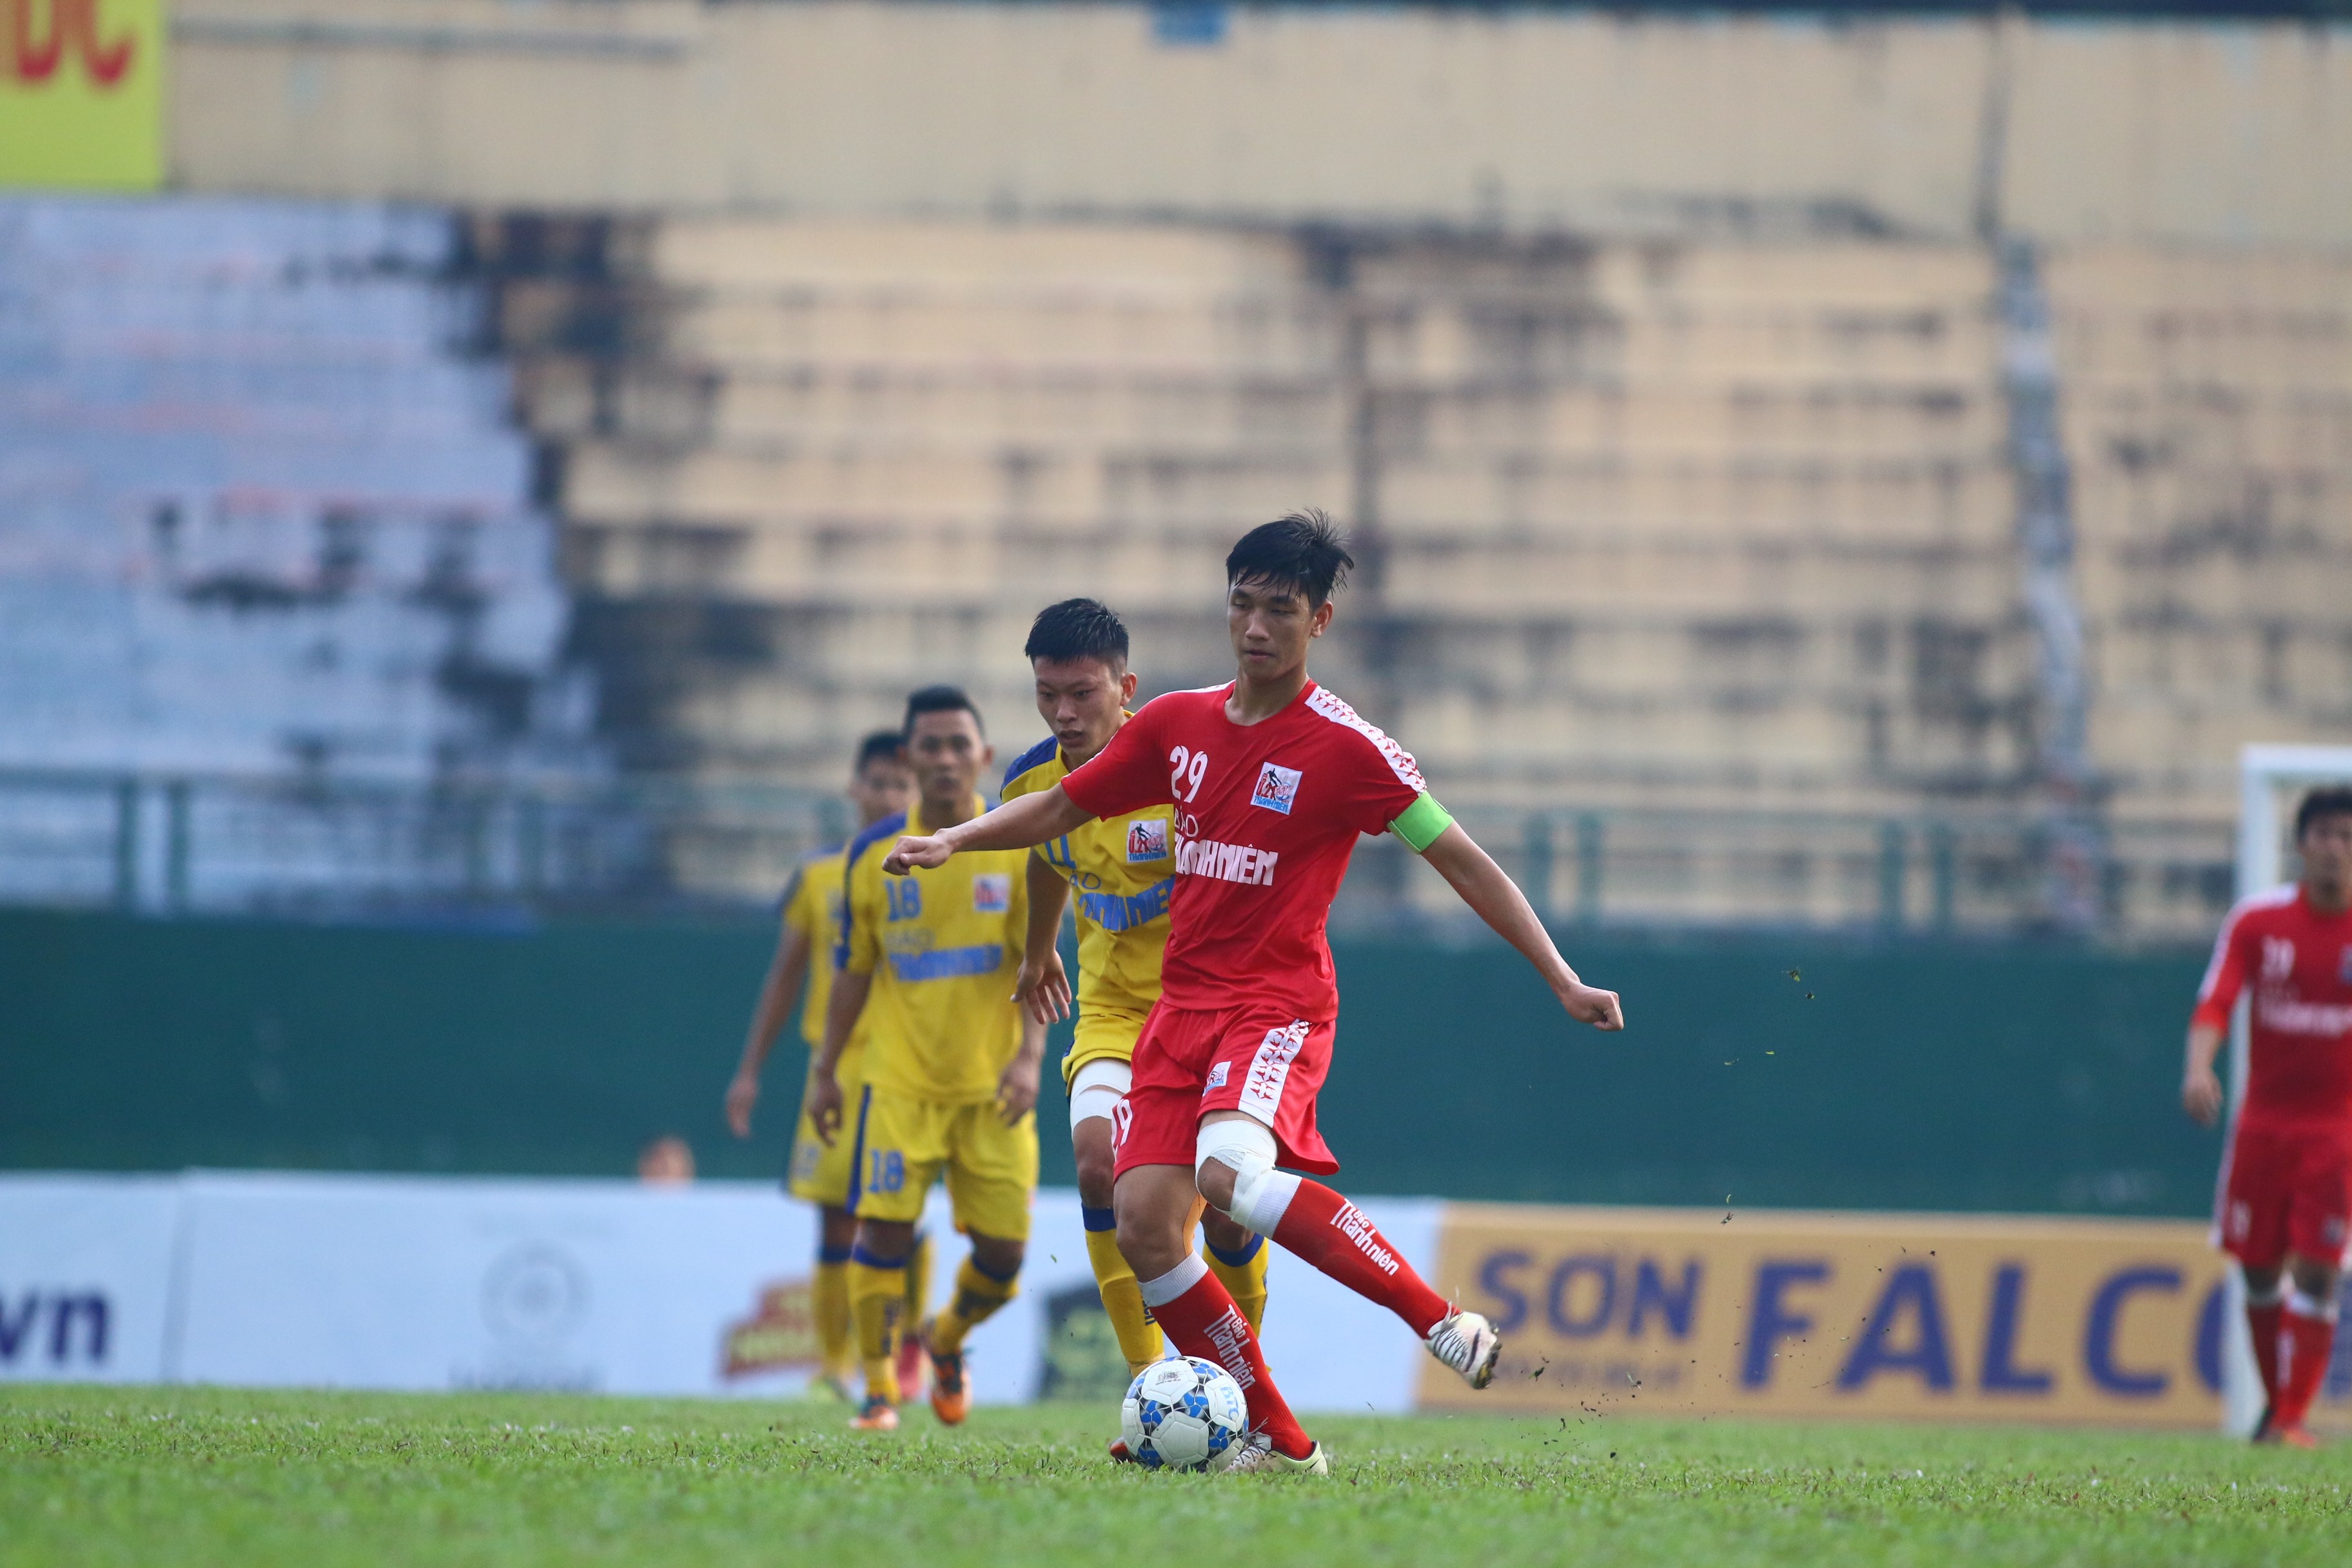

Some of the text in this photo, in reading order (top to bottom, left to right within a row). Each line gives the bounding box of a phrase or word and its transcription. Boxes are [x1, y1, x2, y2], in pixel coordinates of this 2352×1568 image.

[1170, 745, 1208, 803] 29
[884, 877, 922, 923] 18
[868, 1148, 904, 1194] 18
[1739, 1260, 2223, 1398] FALC
